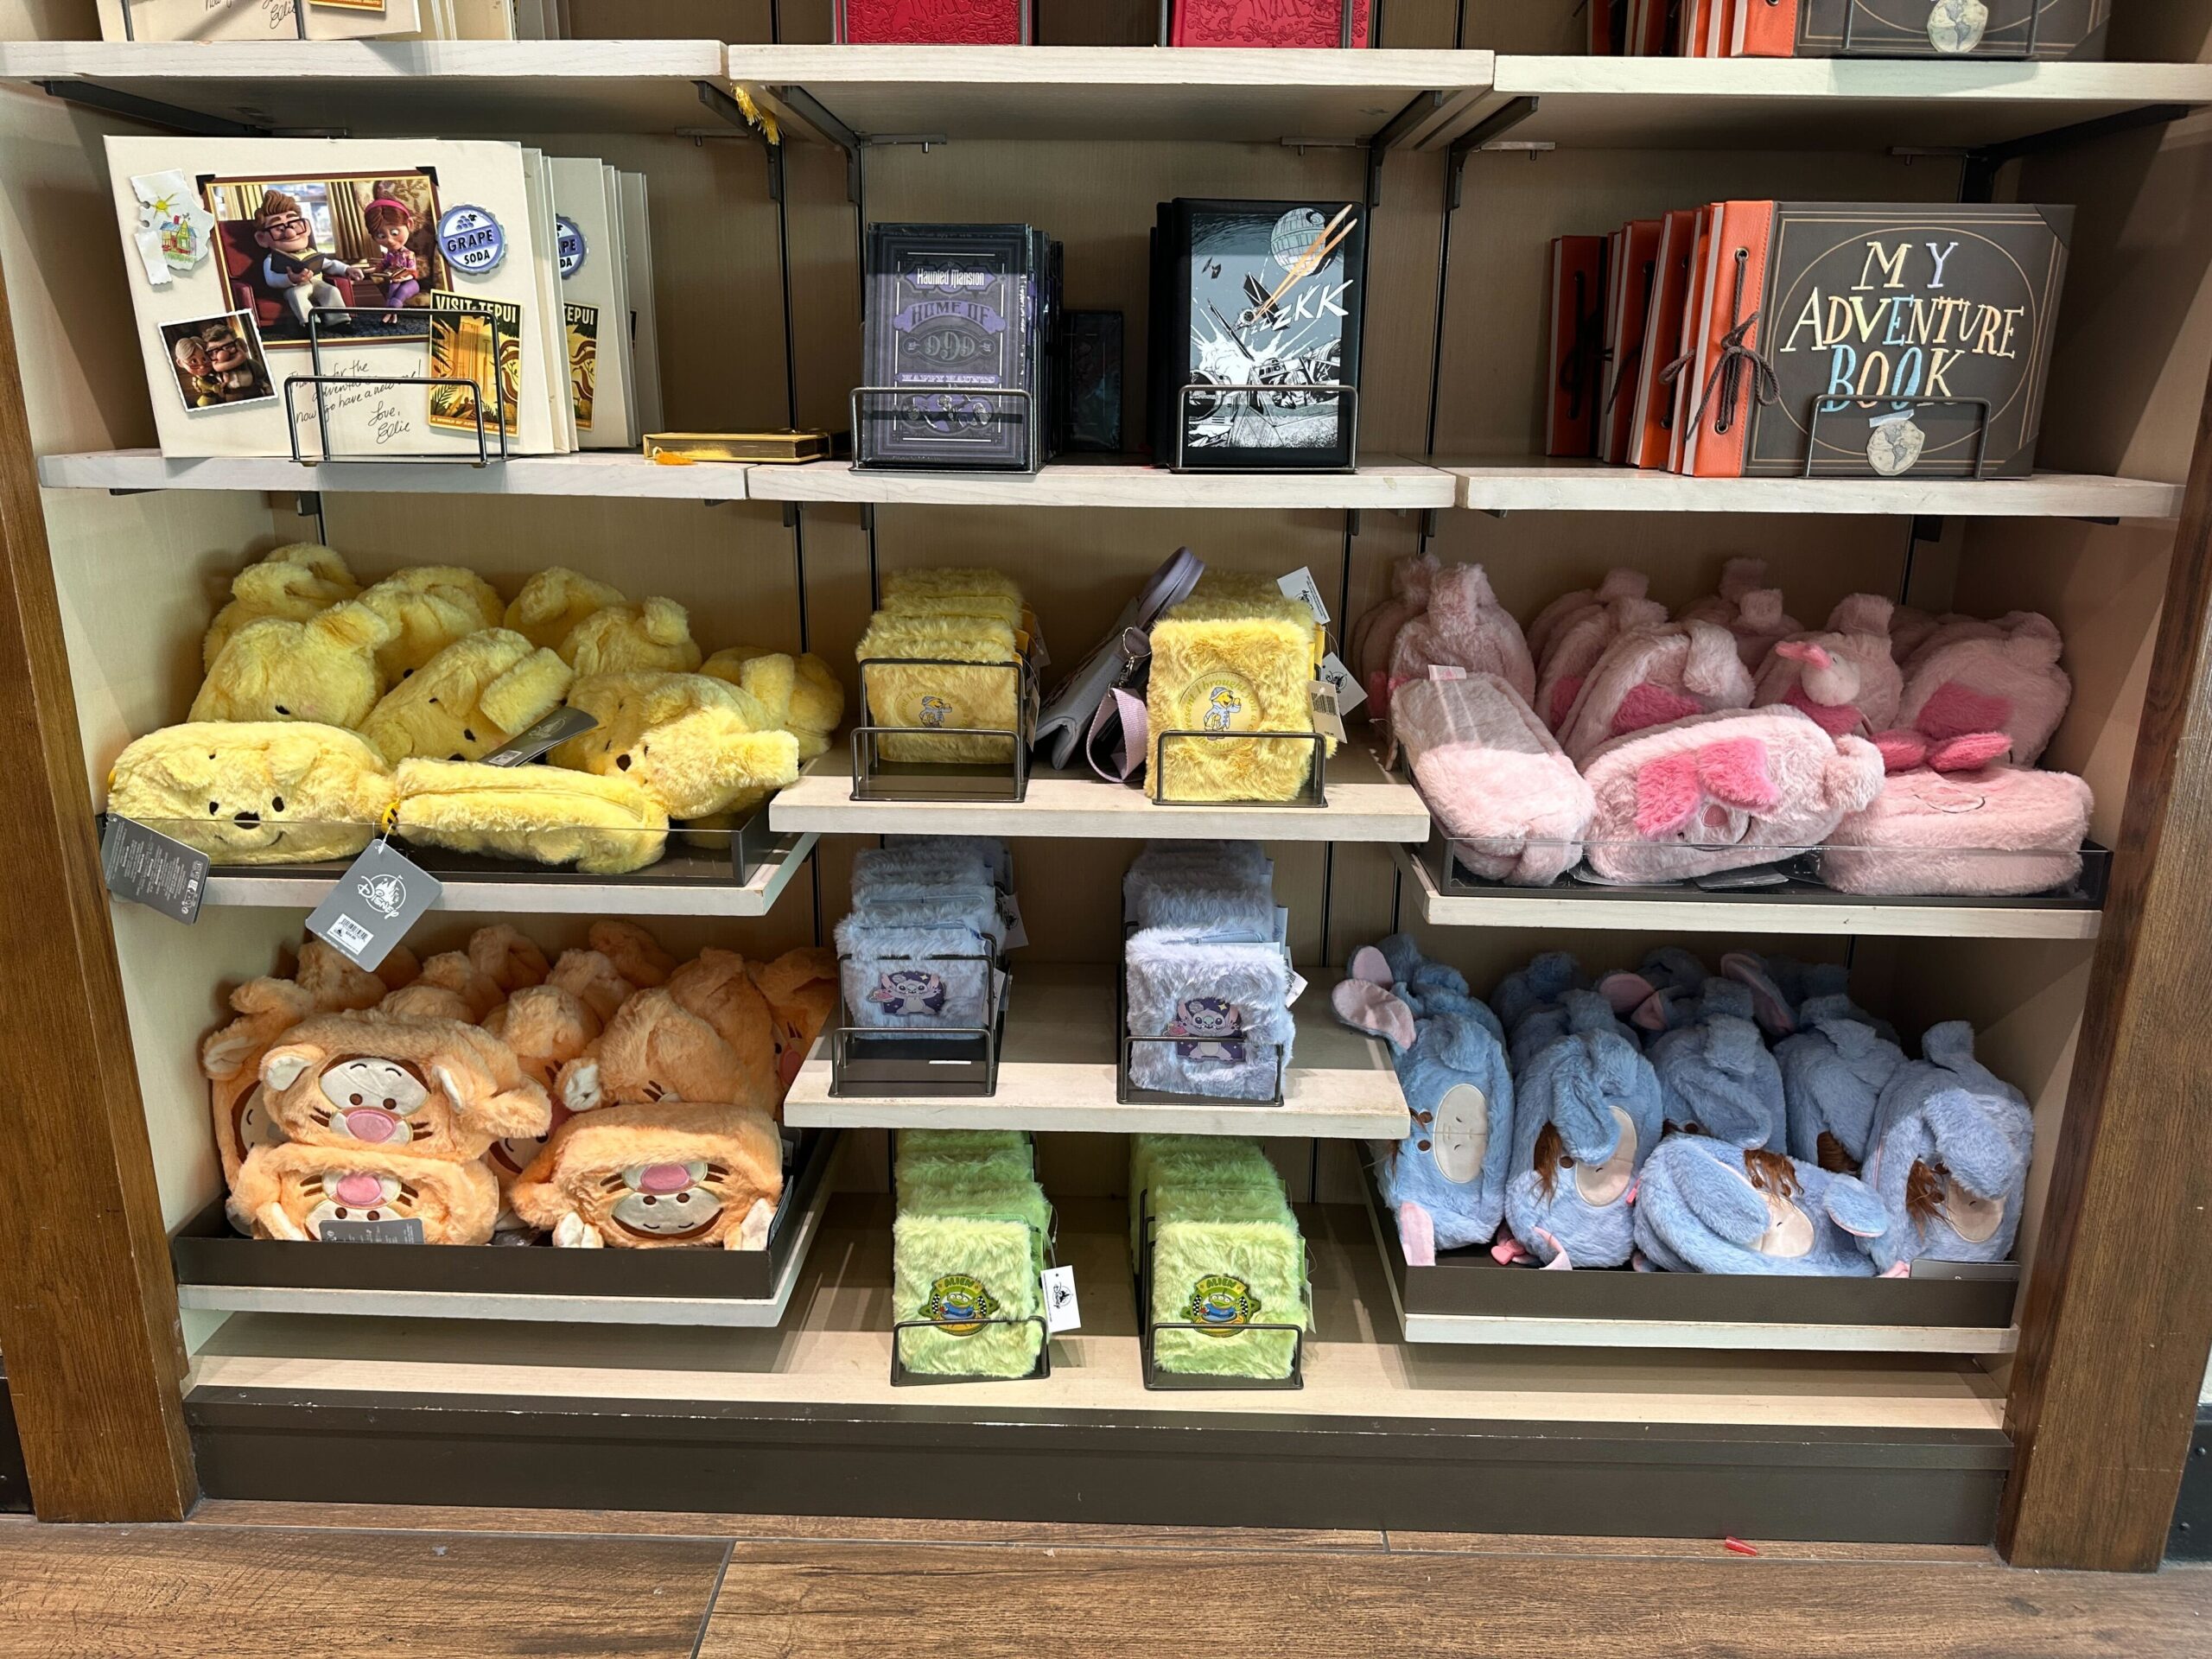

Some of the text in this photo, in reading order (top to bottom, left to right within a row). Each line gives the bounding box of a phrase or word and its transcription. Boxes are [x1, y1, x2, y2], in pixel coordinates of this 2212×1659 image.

[447, 229, 494, 252] GRAPE
[463, 250, 491, 264] SODA
[559, 257, 573, 269] DA
[1851, 241, 1959, 290] MY
[917, 268, 984, 289] Haunted Mansion
[435, 295, 517, 323] VISIT TEPUI
[563, 306, 594, 326] EPUI
[912, 302, 990, 326] HOME OF
[1779, 287, 2024, 359] ADVENTURE
[925, 331, 976, 360] 999
[349, 359, 369, 378] the
[1820, 345, 1966, 412] BOOK
[296, 410, 317, 423] now
[339, 394, 363, 407] have
[373, 381, 395, 395] new
[368, 401, 401, 426] Love,
[376, 421, 411, 444] Ellie
[944, 1277, 976, 1288] ALIEN
[1206, 1278, 1237, 1288] ALIEN
